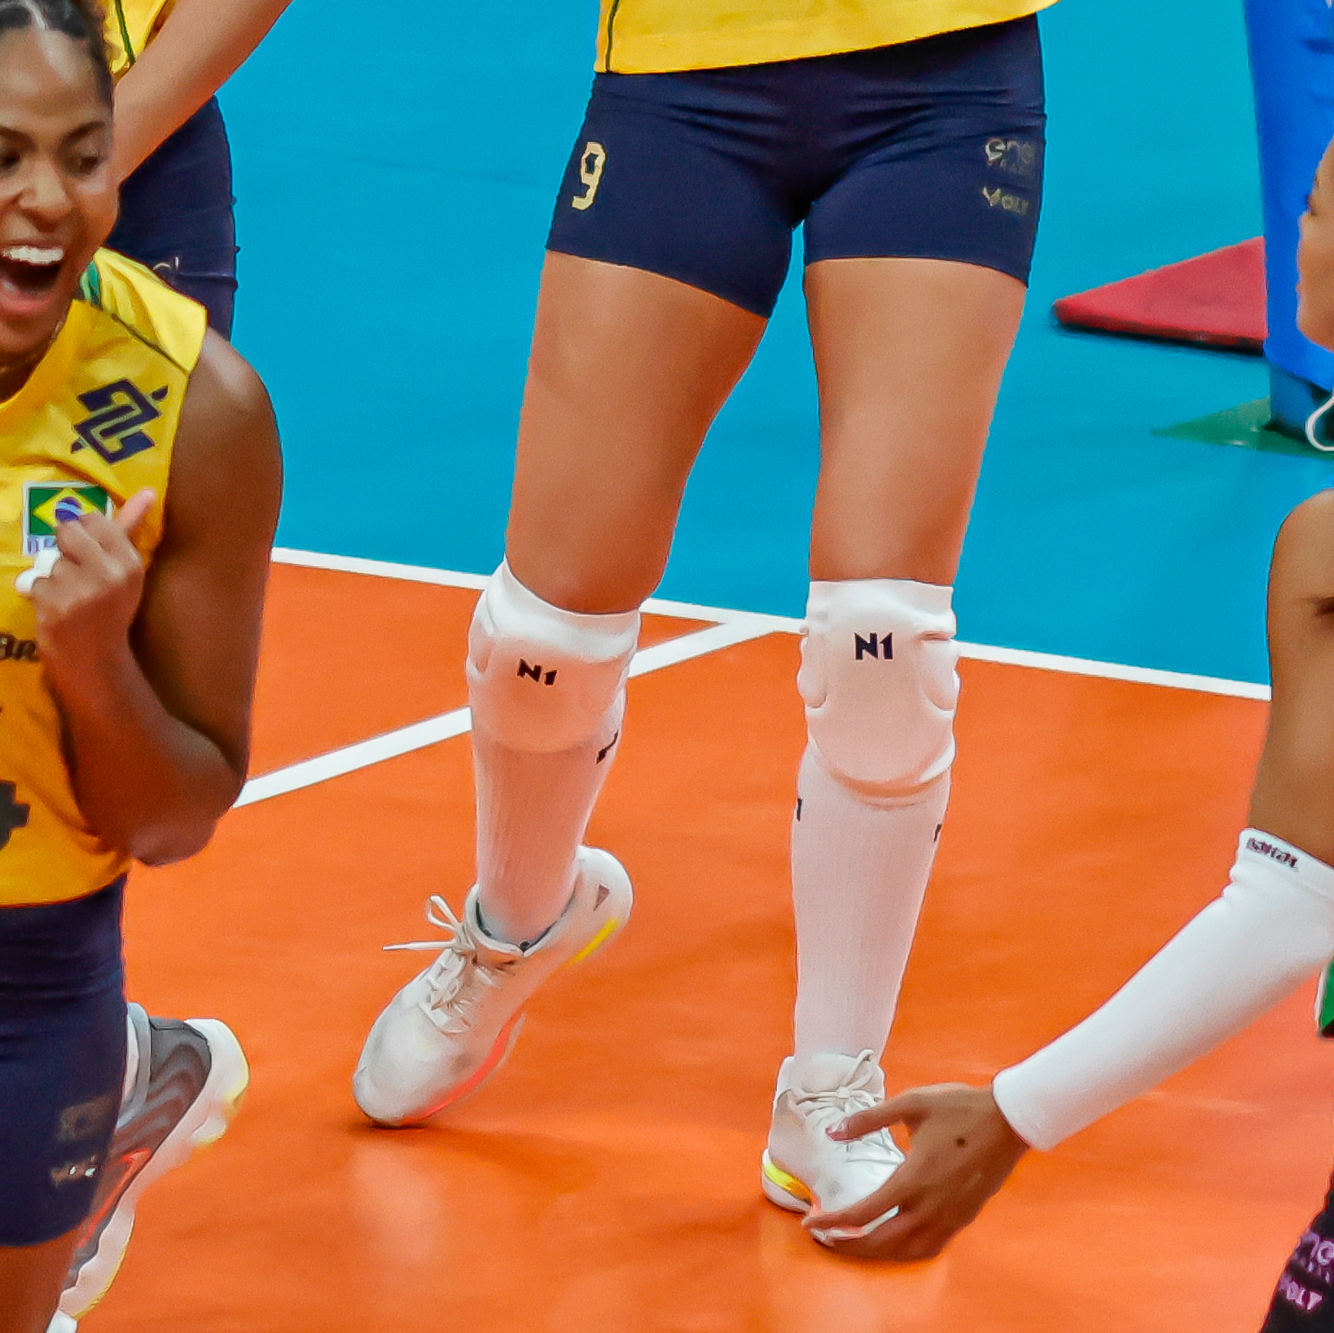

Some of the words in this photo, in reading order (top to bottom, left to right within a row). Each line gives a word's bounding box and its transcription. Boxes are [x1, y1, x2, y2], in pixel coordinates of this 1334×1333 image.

[571, 142, 606, 211] 9
[854, 632, 895, 661] N1
[516, 658, 558, 687] N1
